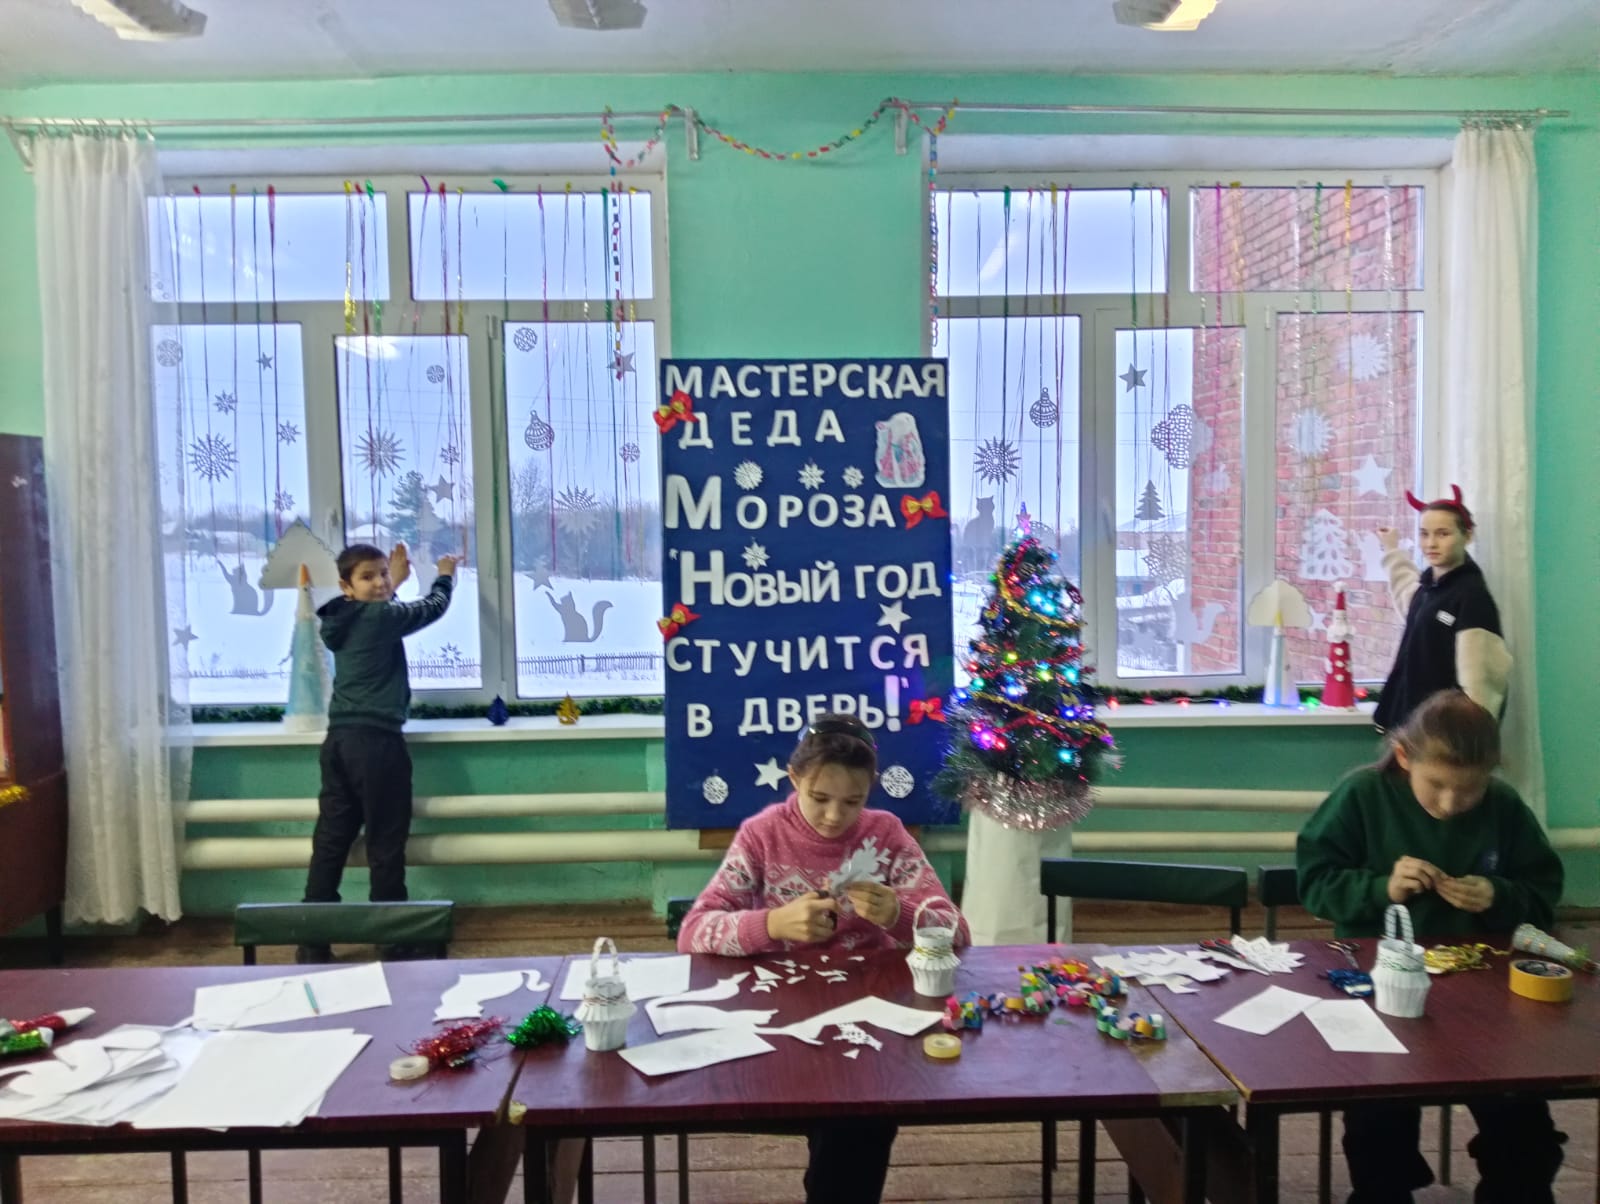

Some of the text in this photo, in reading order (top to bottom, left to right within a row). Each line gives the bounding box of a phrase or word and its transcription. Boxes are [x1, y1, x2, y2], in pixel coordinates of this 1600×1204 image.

[665, 363, 945, 399] МАСТЕРСКАЯ
[678, 409, 845, 449] ДЕДА
[854, 561, 942, 600] ГОД
[666, 633, 930, 677] СТУЧИТСЯ
[687, 703, 713, 737] В
